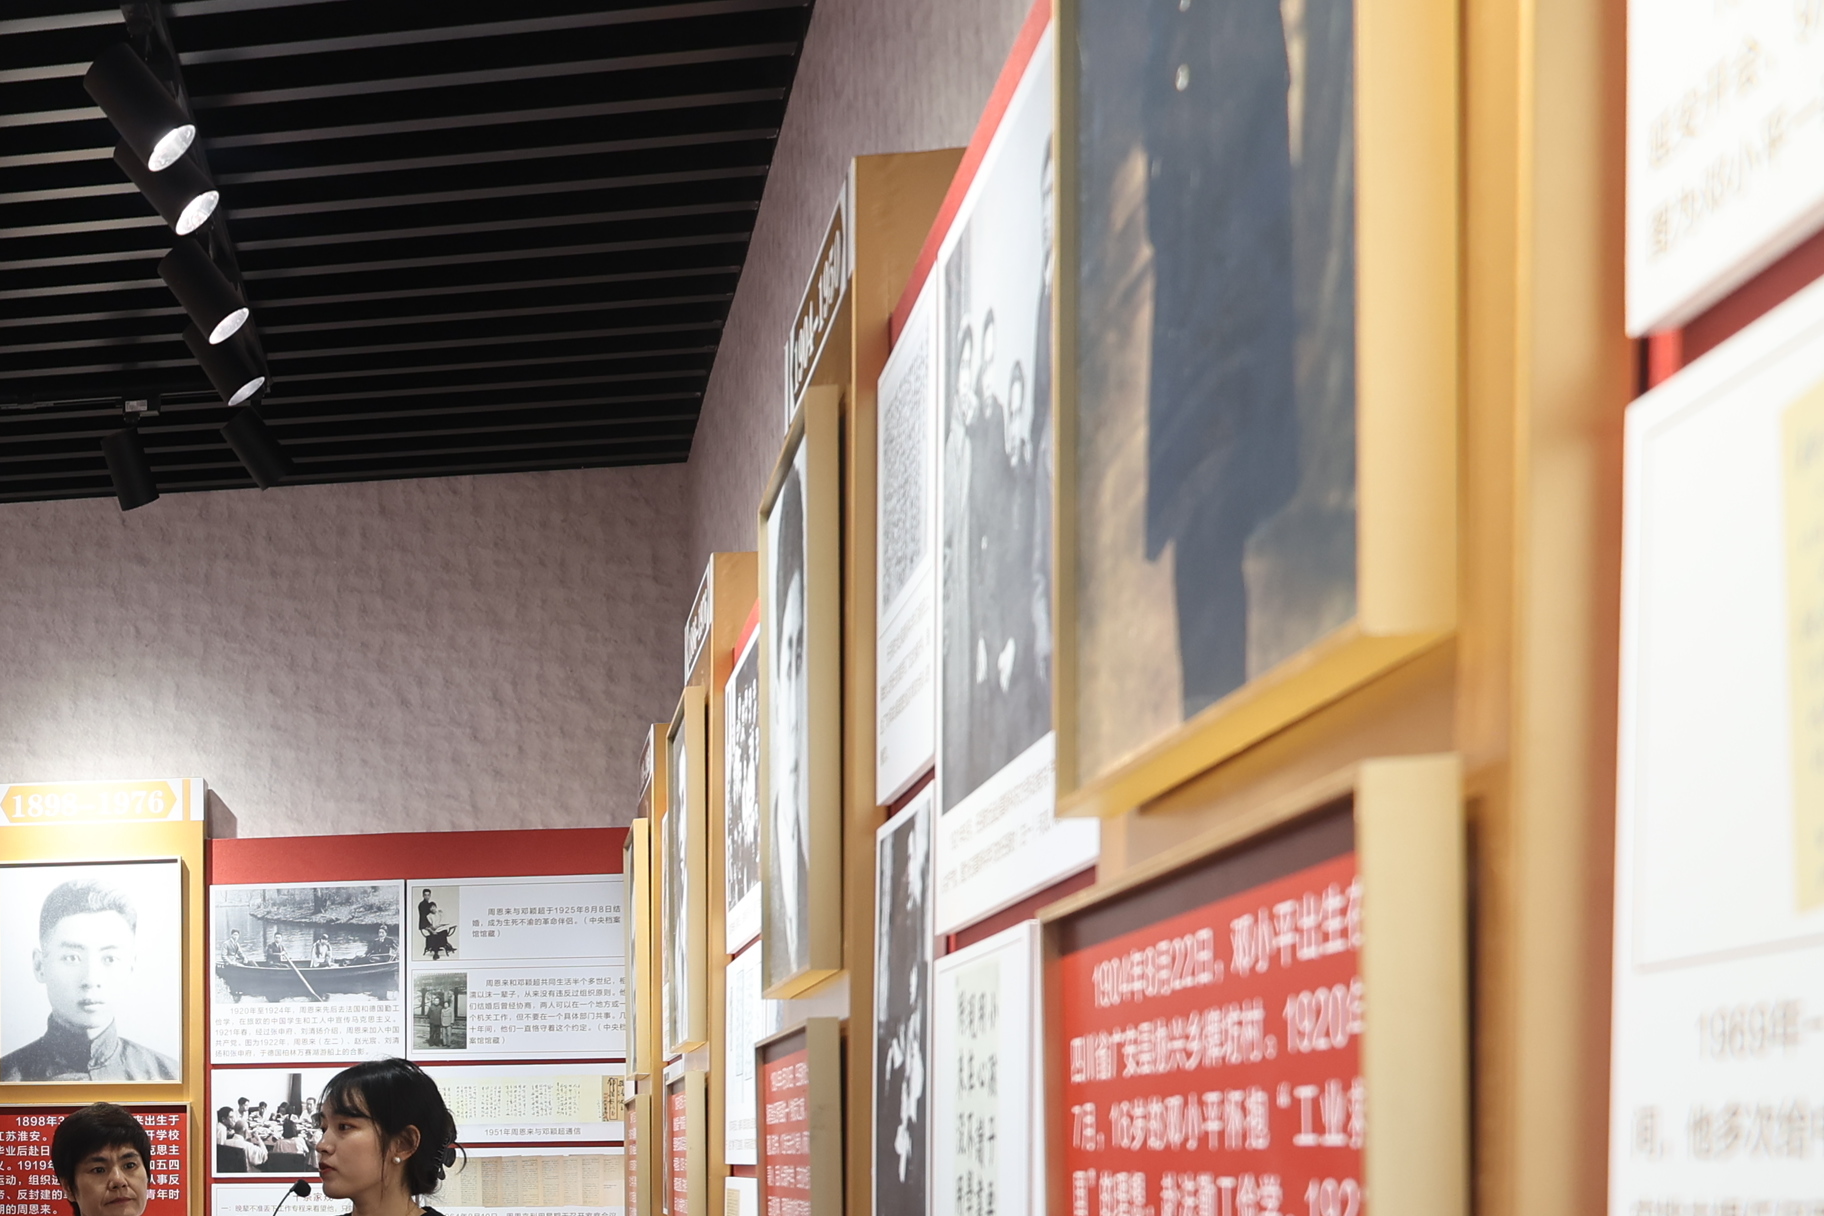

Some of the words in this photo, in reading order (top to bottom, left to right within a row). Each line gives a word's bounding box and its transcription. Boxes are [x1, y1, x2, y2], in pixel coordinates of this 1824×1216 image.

[12, 789, 165, 819] 1898-1976
[487, 905, 622, 916] 周恩来与邓颖超于1925年8月8日结
[471, 930, 503, 938] 馆馆藏）
[468, 1037, 507, 1045] 案馆馆藏）
[484, 1128, 582, 1136] 1951年周恩来与邓颖超通信
